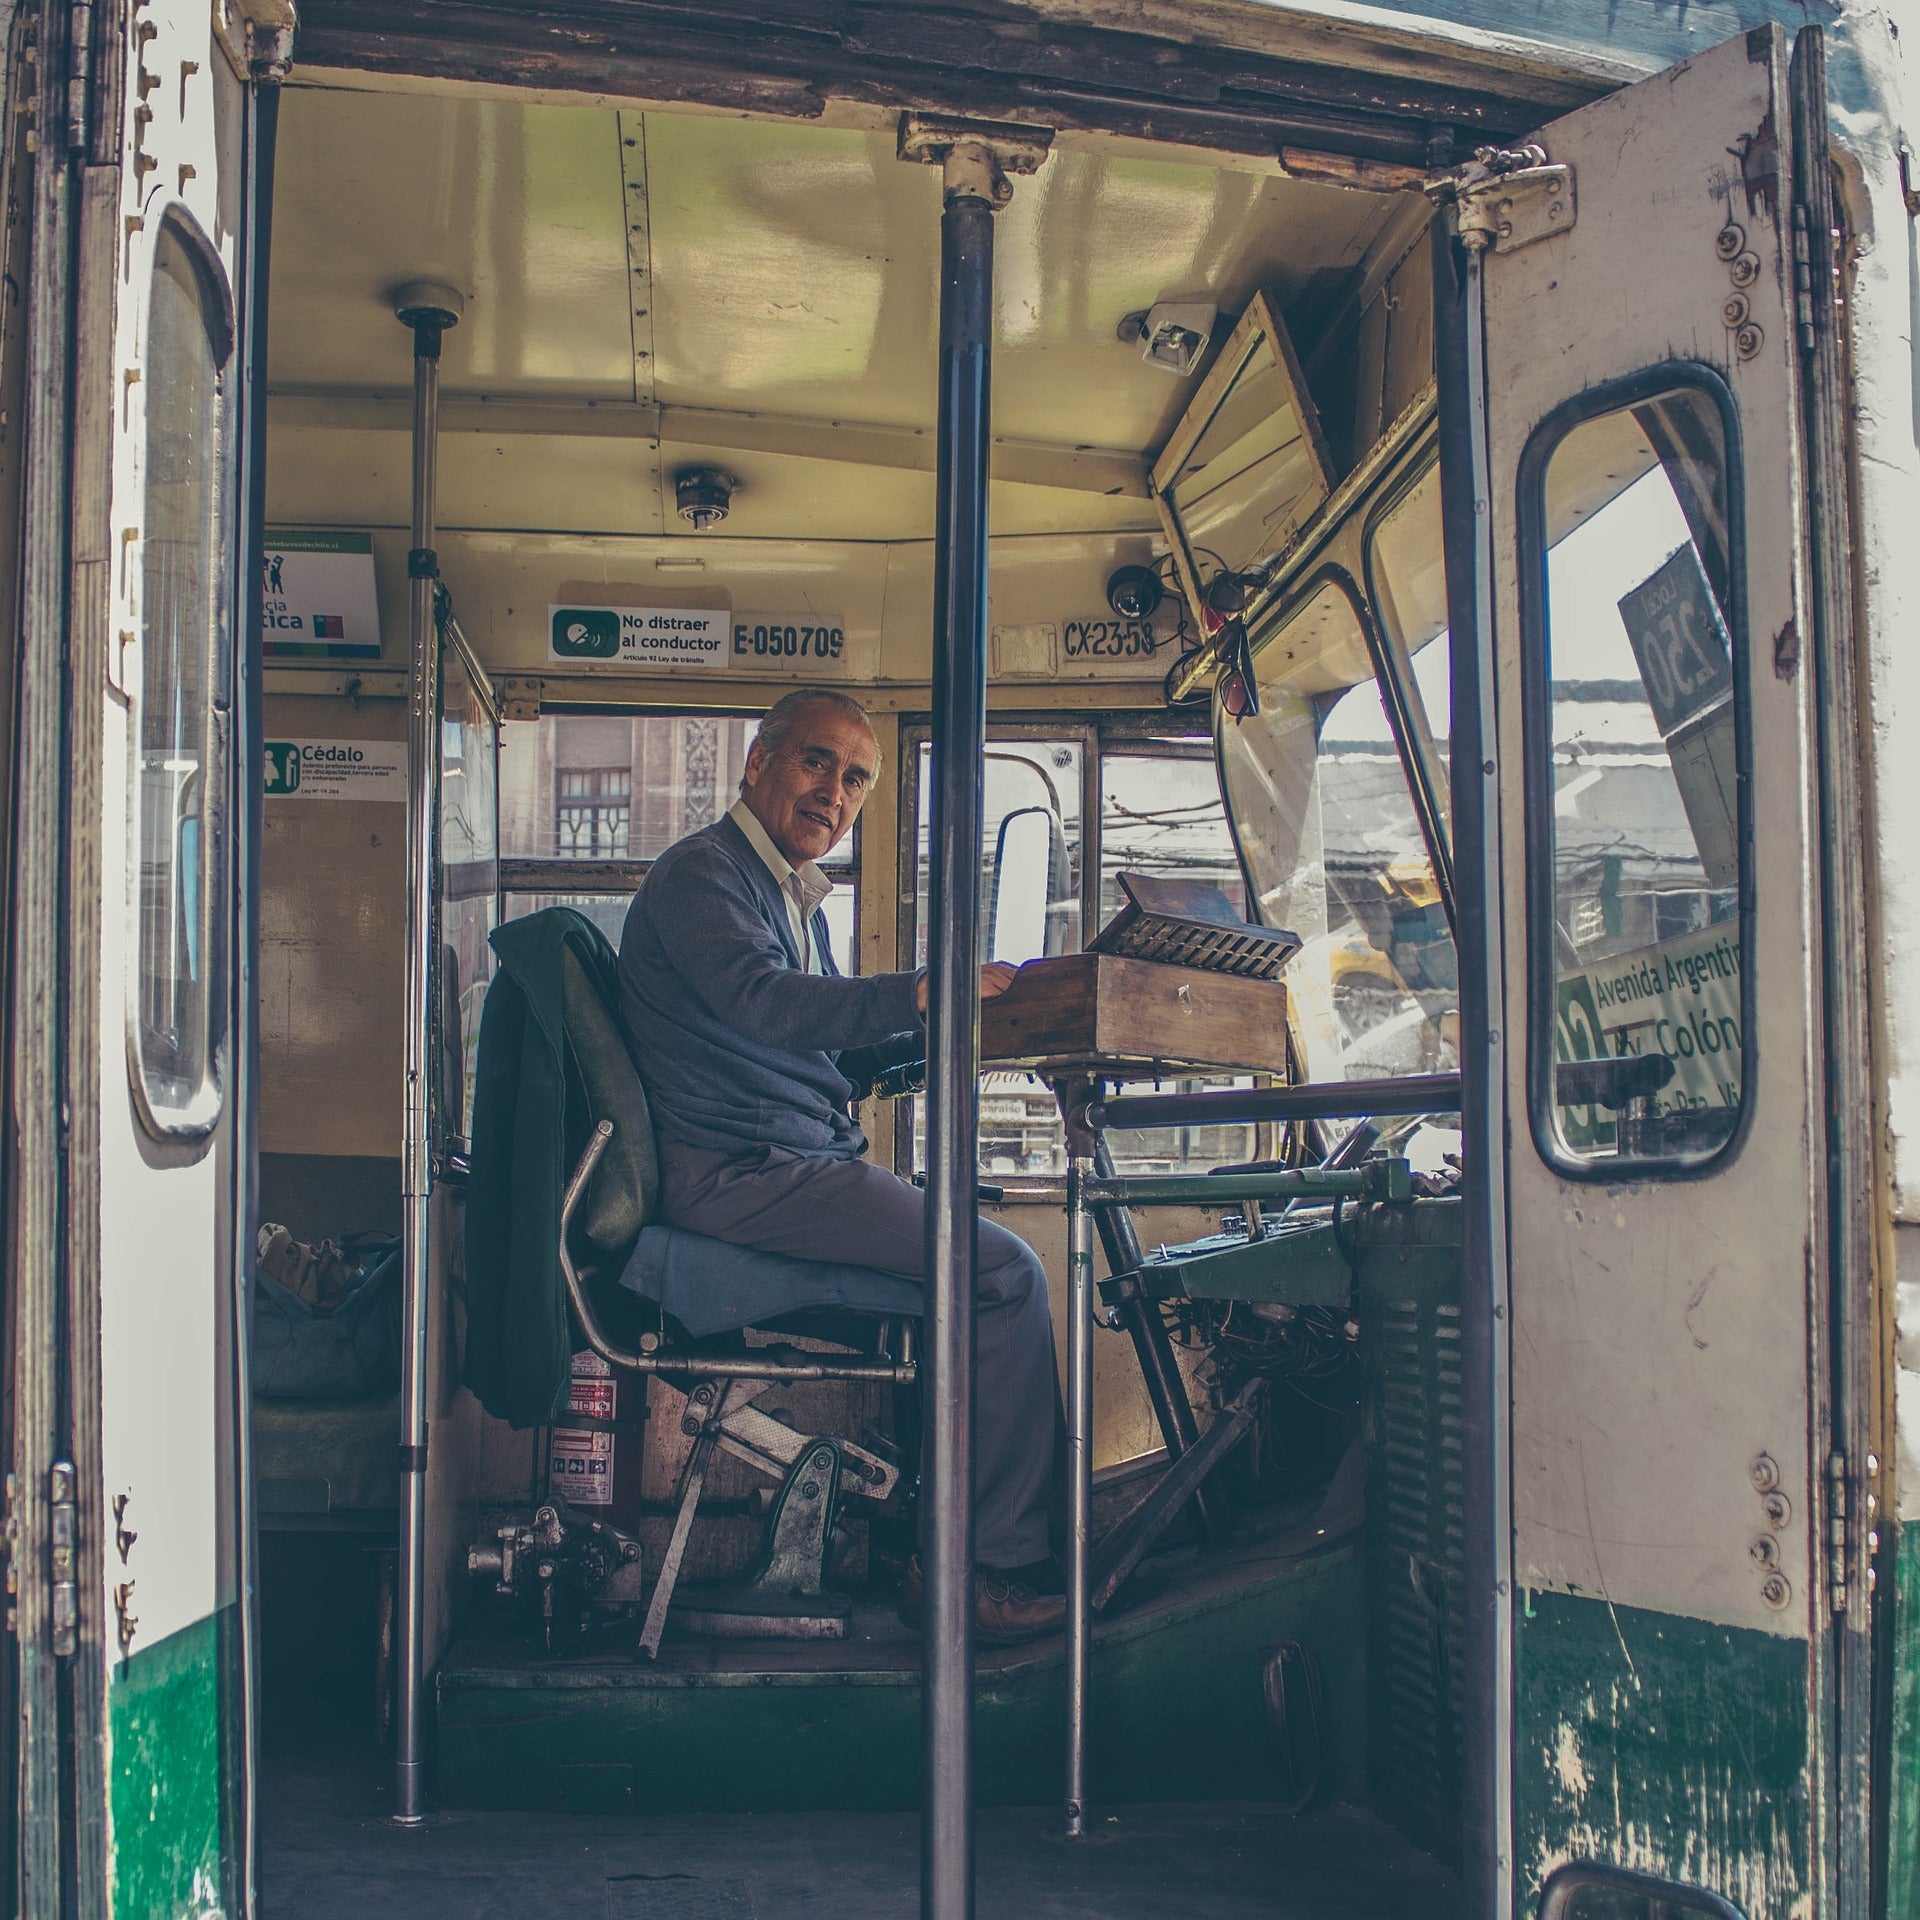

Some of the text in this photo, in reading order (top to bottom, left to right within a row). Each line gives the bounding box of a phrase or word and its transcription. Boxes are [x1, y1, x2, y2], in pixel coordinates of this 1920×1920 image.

[263, 599, 287, 611] cia
[622, 615, 710, 631] No distraer
[622, 634, 721, 651] al conductor
[658, 655, 669, 663] Ley
[302, 745, 364, 762] Cédalo
[1594, 960, 1664, 1008] Avenida
[1656, 1009, 1741, 1061] Colón
